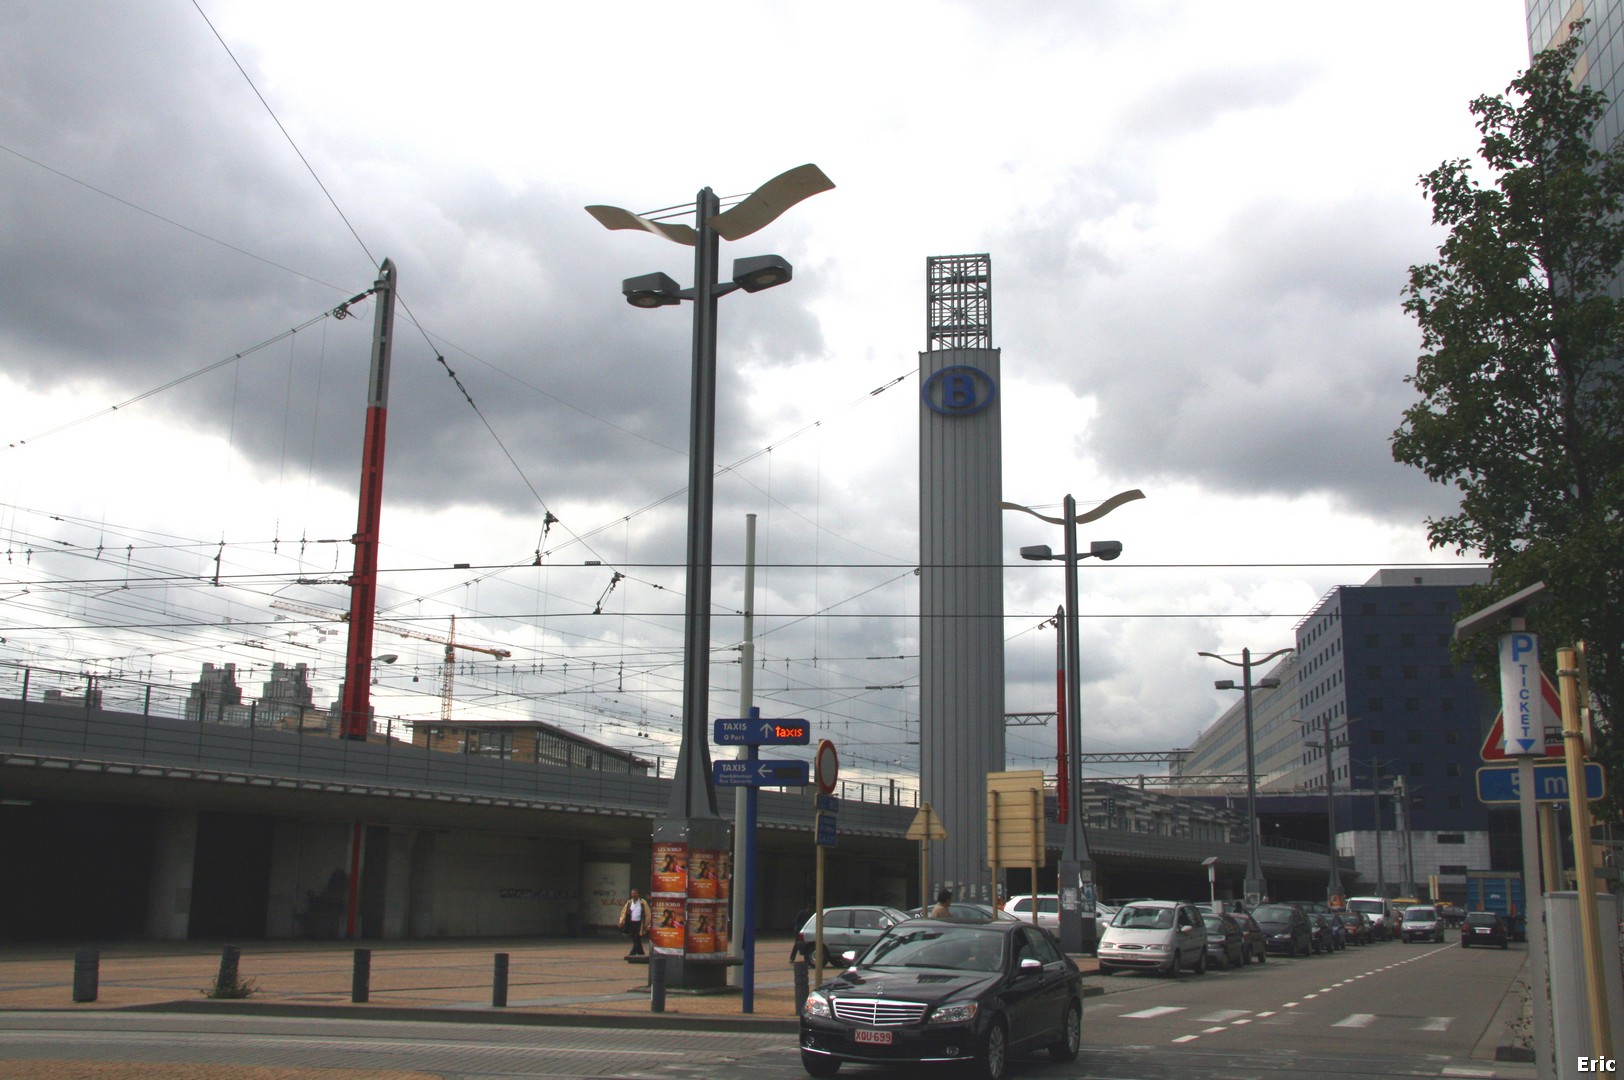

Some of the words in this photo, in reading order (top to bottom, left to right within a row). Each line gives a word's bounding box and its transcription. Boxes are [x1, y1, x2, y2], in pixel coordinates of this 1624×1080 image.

[943, 373, 977, 407] B
[1512, 635, 1533, 662] P
[1518, 664, 1530, 737] TICKET
[723, 723, 747, 731] TAXIS
[775, 726, 803, 738] taxis
[722, 763, 747, 772] TAXIS
[1543, 776, 1568, 794] m
